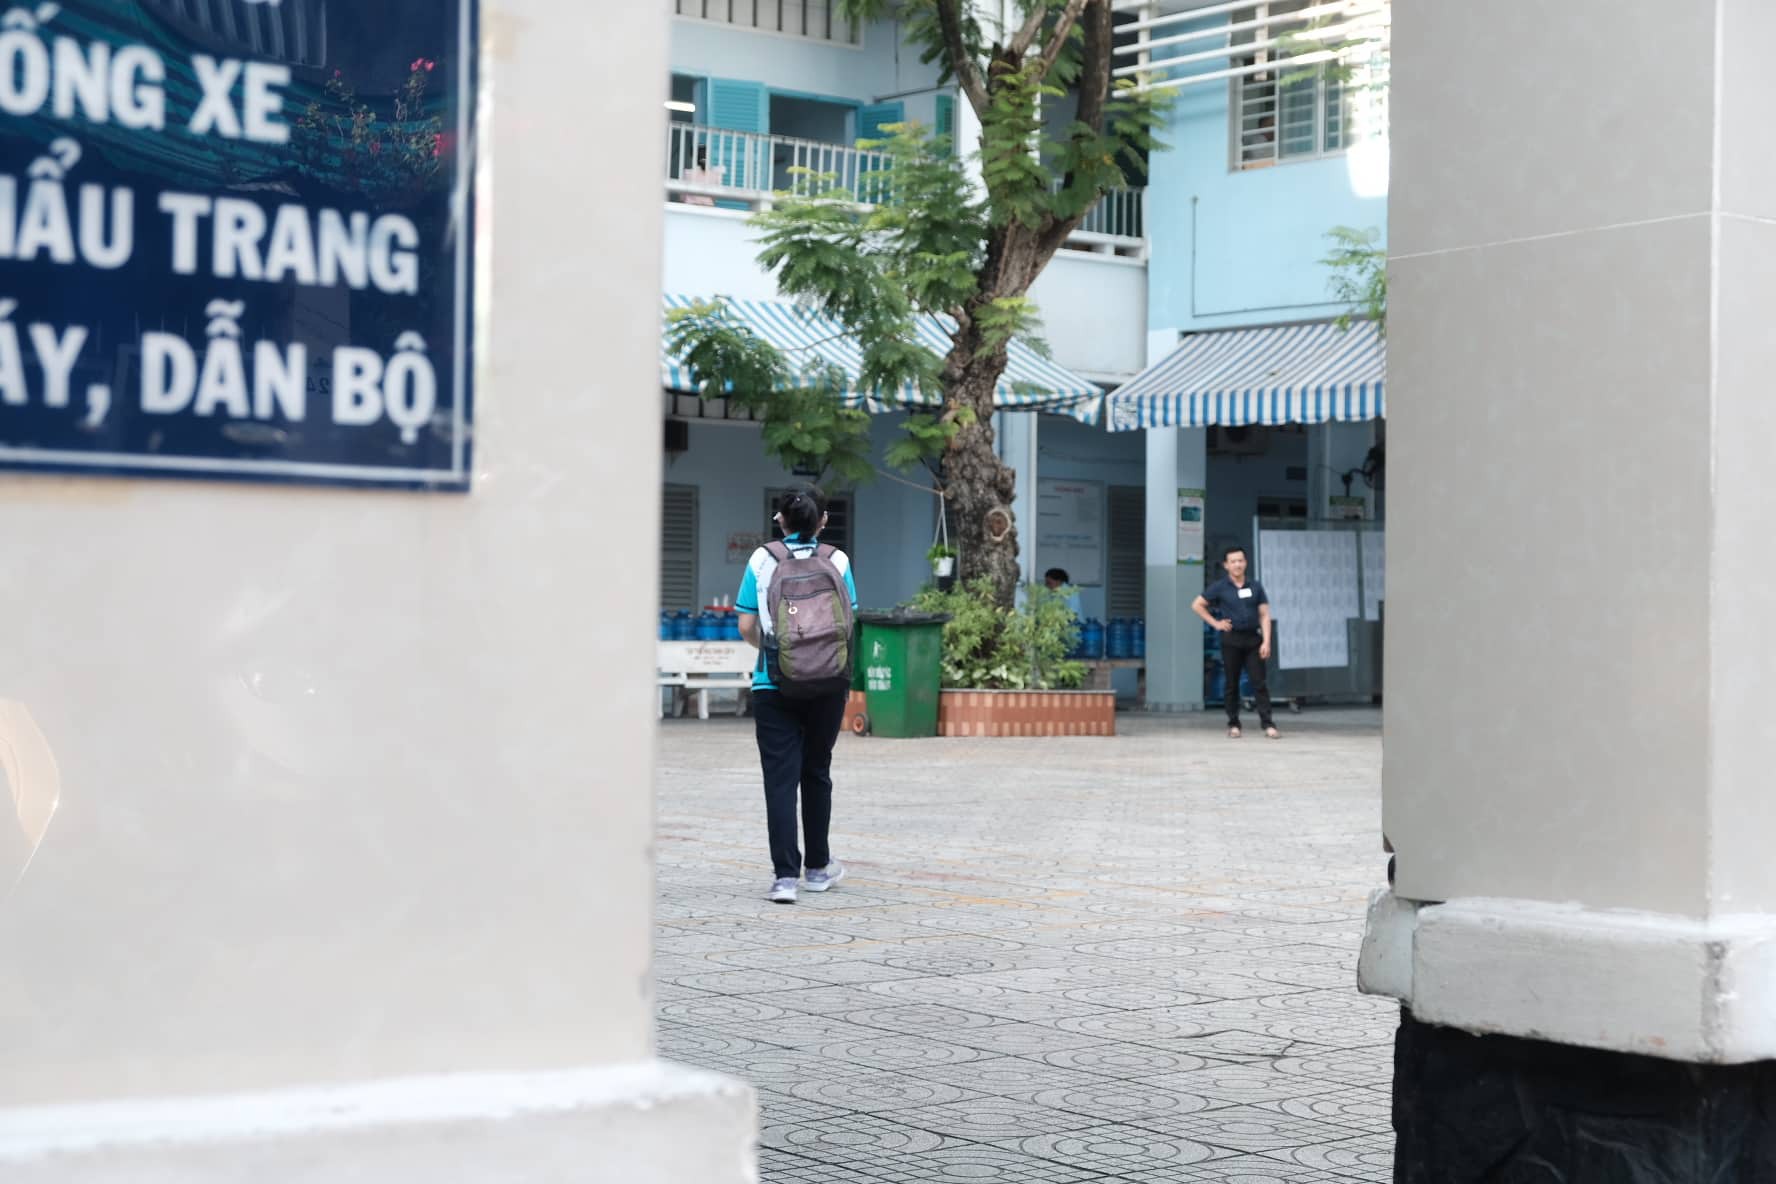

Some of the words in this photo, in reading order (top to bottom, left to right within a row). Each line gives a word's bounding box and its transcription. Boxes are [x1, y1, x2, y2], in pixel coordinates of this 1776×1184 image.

[0, 3, 166, 131] ỐNG
[189, 54, 291, 144] XE
[158, 191, 419, 295] TRANG
[140, 299, 307, 422] DẪN
[332, 331, 437, 444] BỘ
